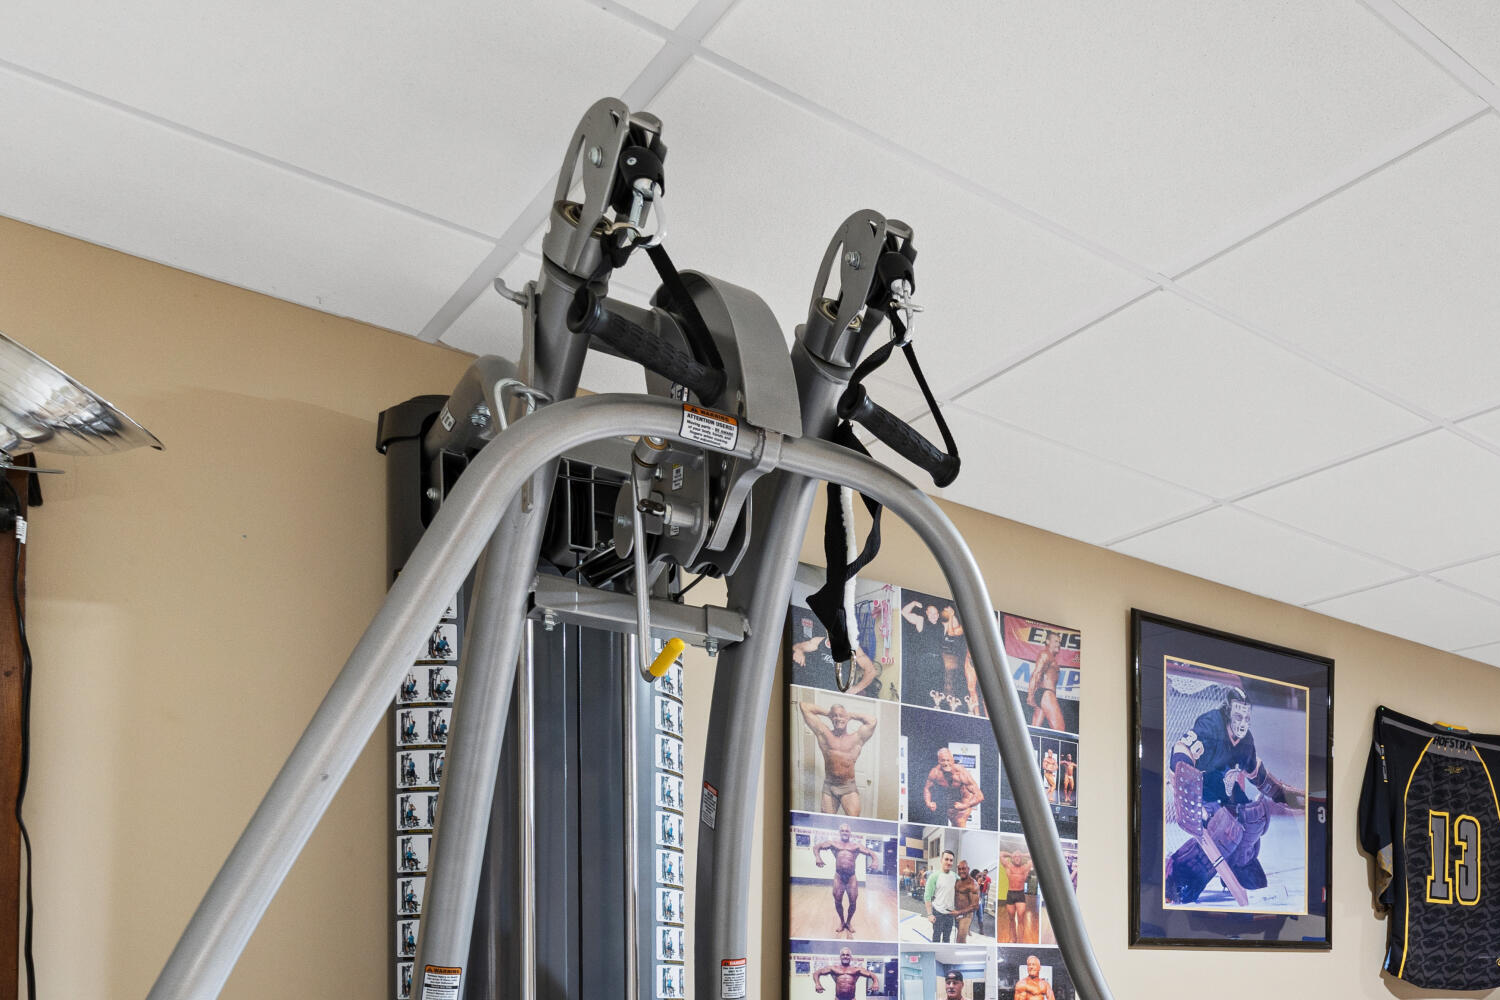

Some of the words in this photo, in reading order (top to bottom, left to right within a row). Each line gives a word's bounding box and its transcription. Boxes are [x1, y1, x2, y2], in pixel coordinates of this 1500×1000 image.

[1181, 730, 1205, 759] 30
[1432, 735, 1473, 752] HOFSTRA
[1426, 809, 1481, 905] 13
